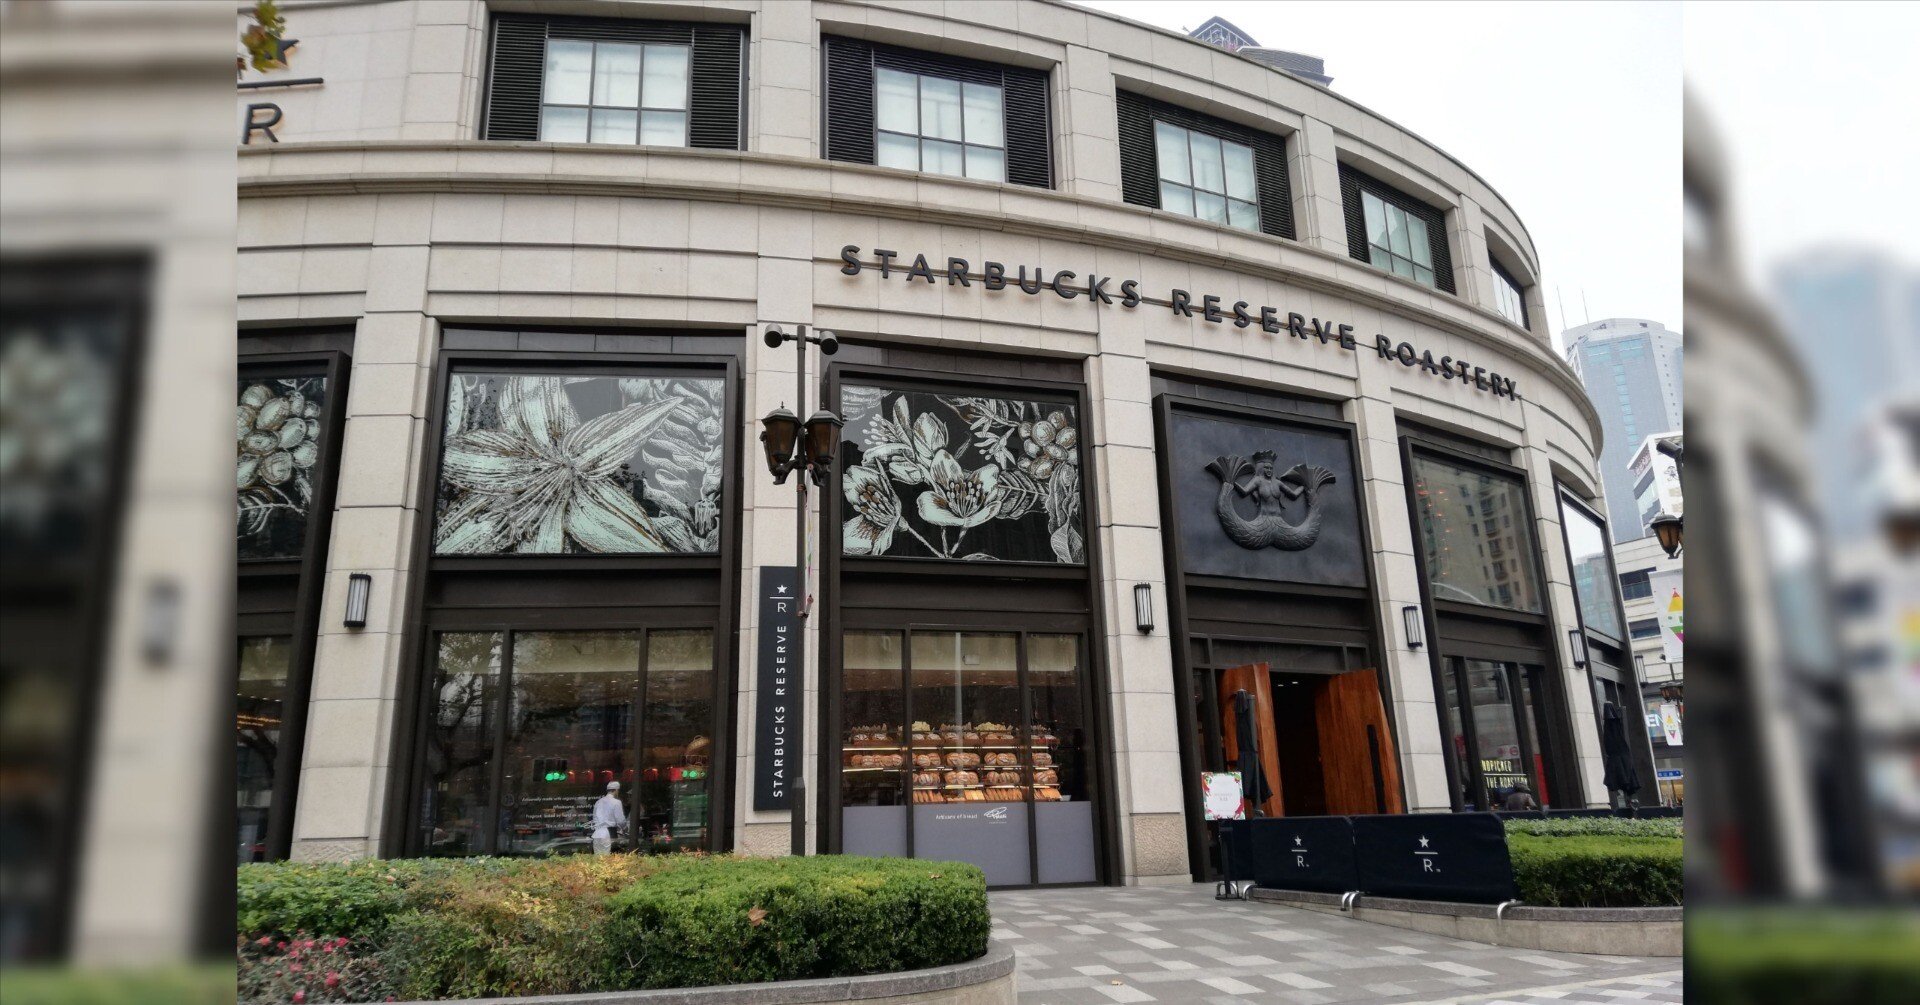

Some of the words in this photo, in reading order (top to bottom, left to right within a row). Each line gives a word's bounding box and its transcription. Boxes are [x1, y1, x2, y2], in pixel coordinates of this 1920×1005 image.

[242, 103, 282, 145] R
[840, 244, 1141, 308] STARBUCKS
[1172, 287, 1356, 350] RESERVE
[1376, 333, 1518, 400] ROASTERY
[777, 602, 787, 613] R
[775, 625, 787, 696] RESERVE
[773, 705, 785, 798] STARBUCKS
[1486, 777, 1498, 789] THE
